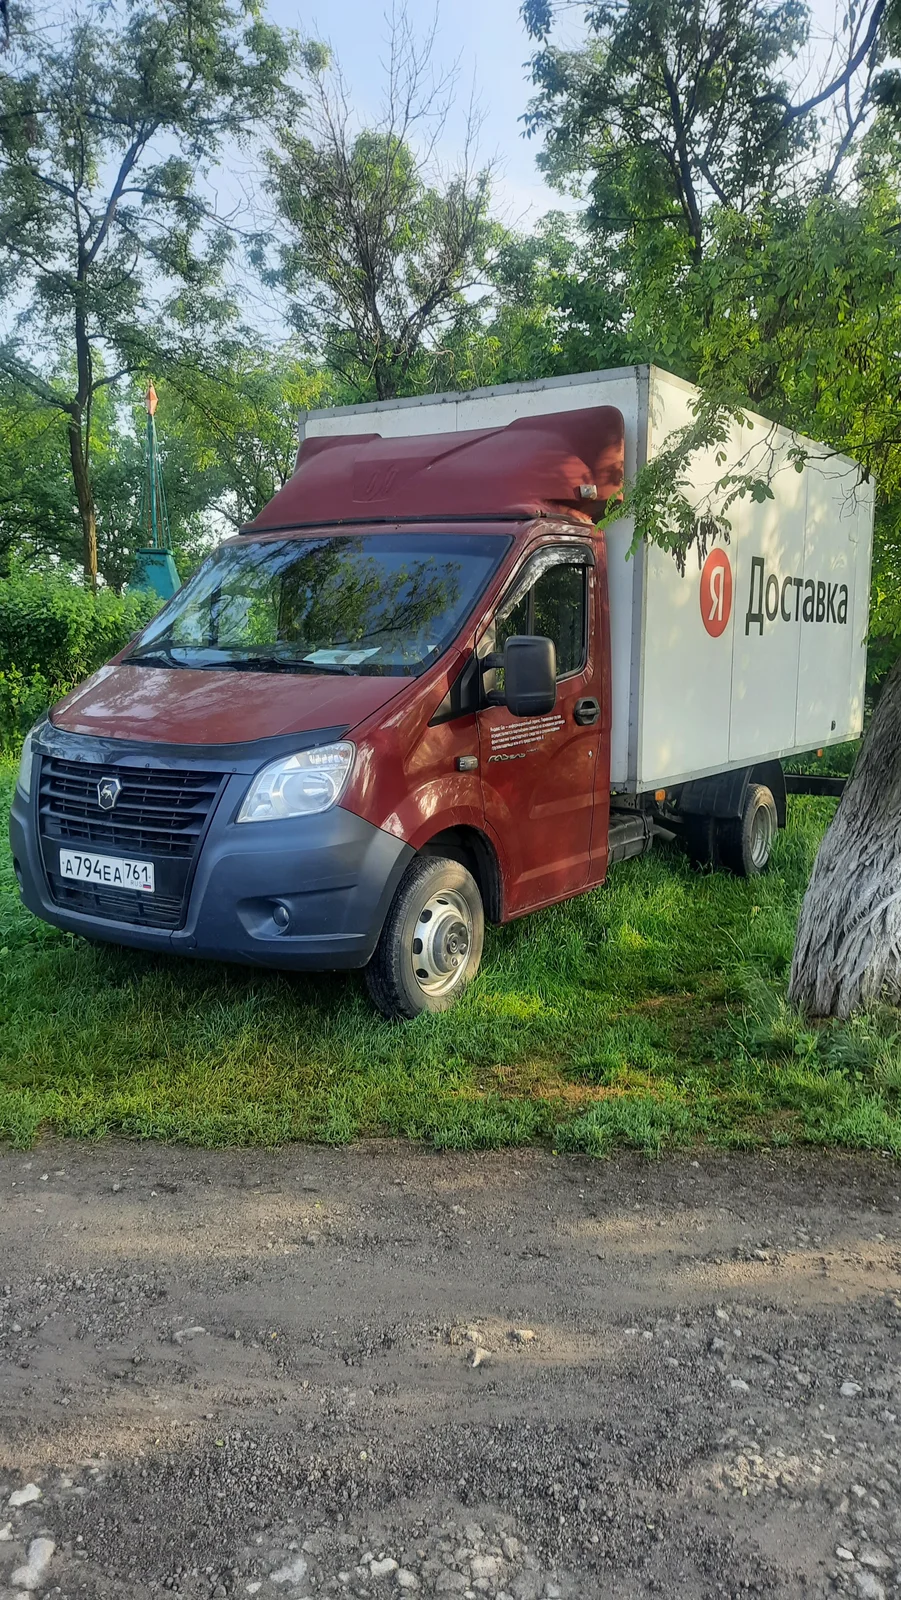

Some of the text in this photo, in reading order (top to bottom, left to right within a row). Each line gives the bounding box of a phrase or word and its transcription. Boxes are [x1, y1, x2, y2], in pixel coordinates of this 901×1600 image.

[708, 556, 848, 636] Я Доставка
[65, 856, 148, 883] А794ЕА 761
[131, 880, 143, 888] RUS
